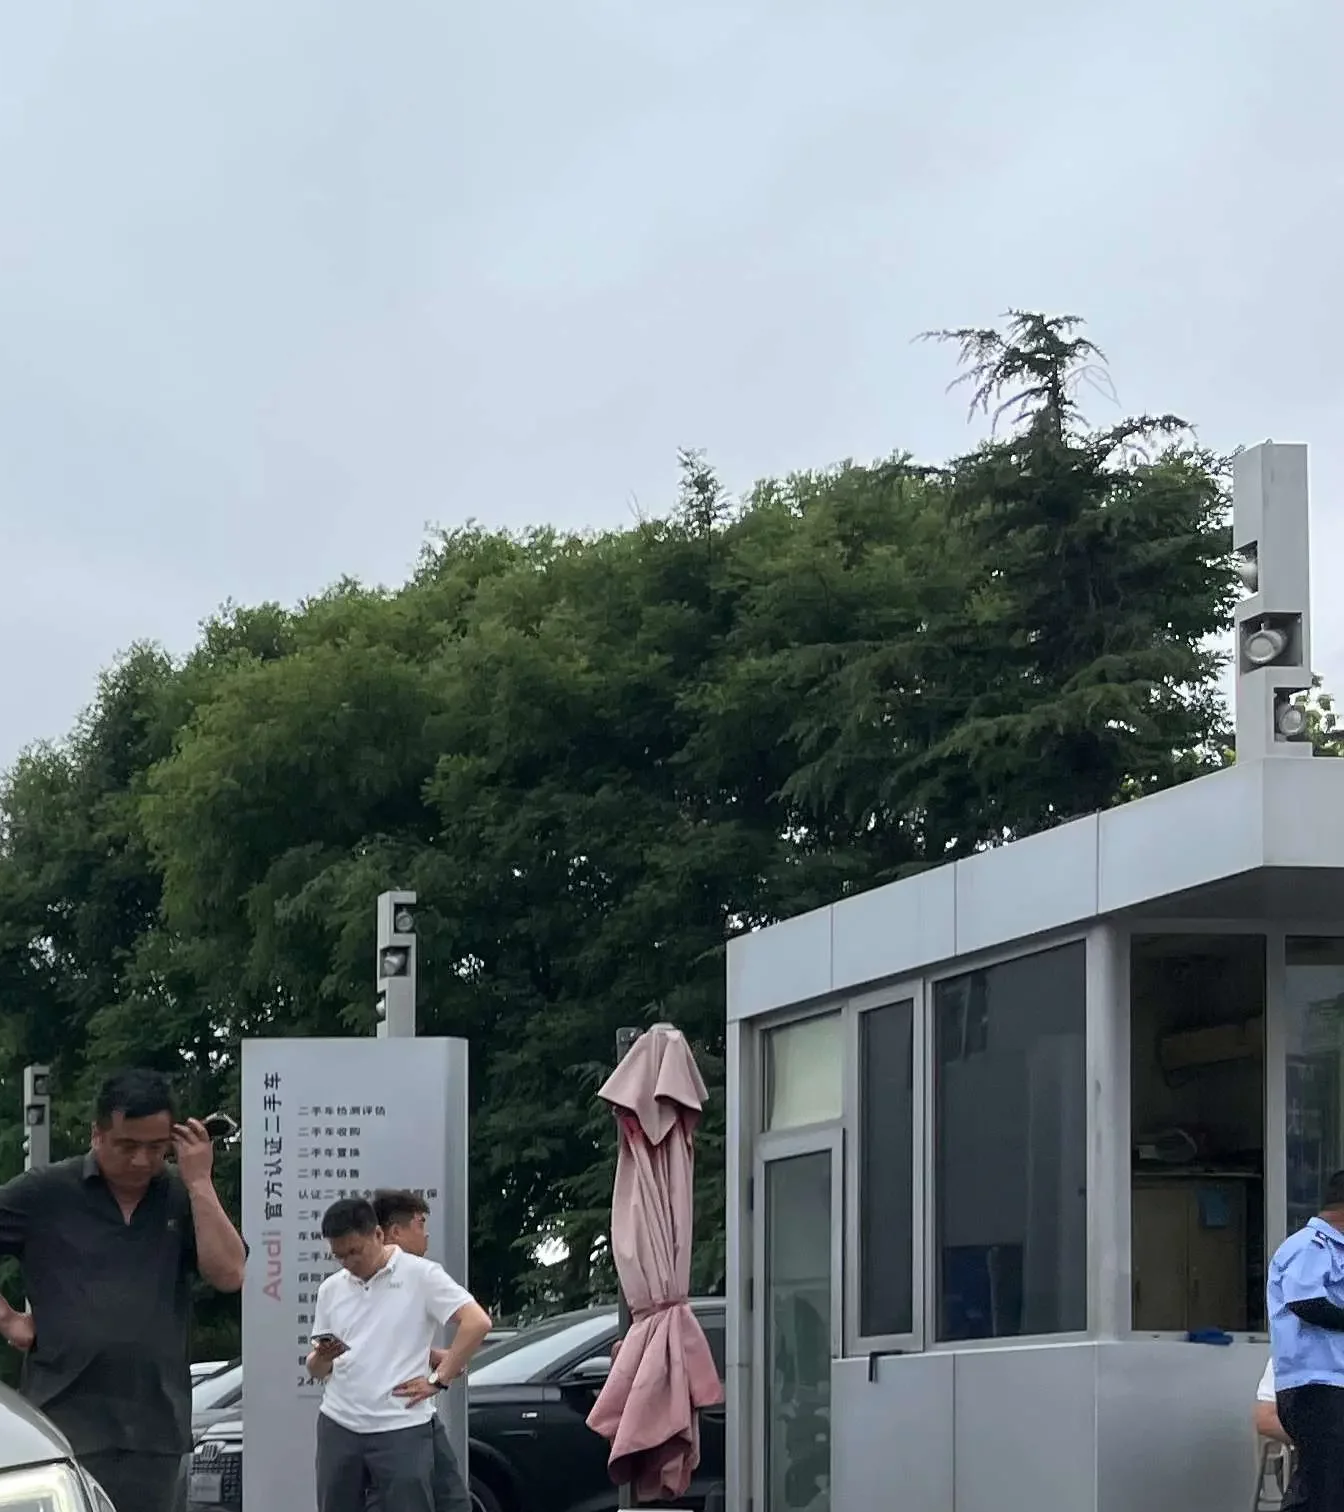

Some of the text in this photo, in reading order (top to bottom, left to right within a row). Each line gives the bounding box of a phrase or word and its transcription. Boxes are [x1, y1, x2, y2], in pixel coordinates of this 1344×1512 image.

[262, 1071, 283, 1302] Audi 官方认证二手车
